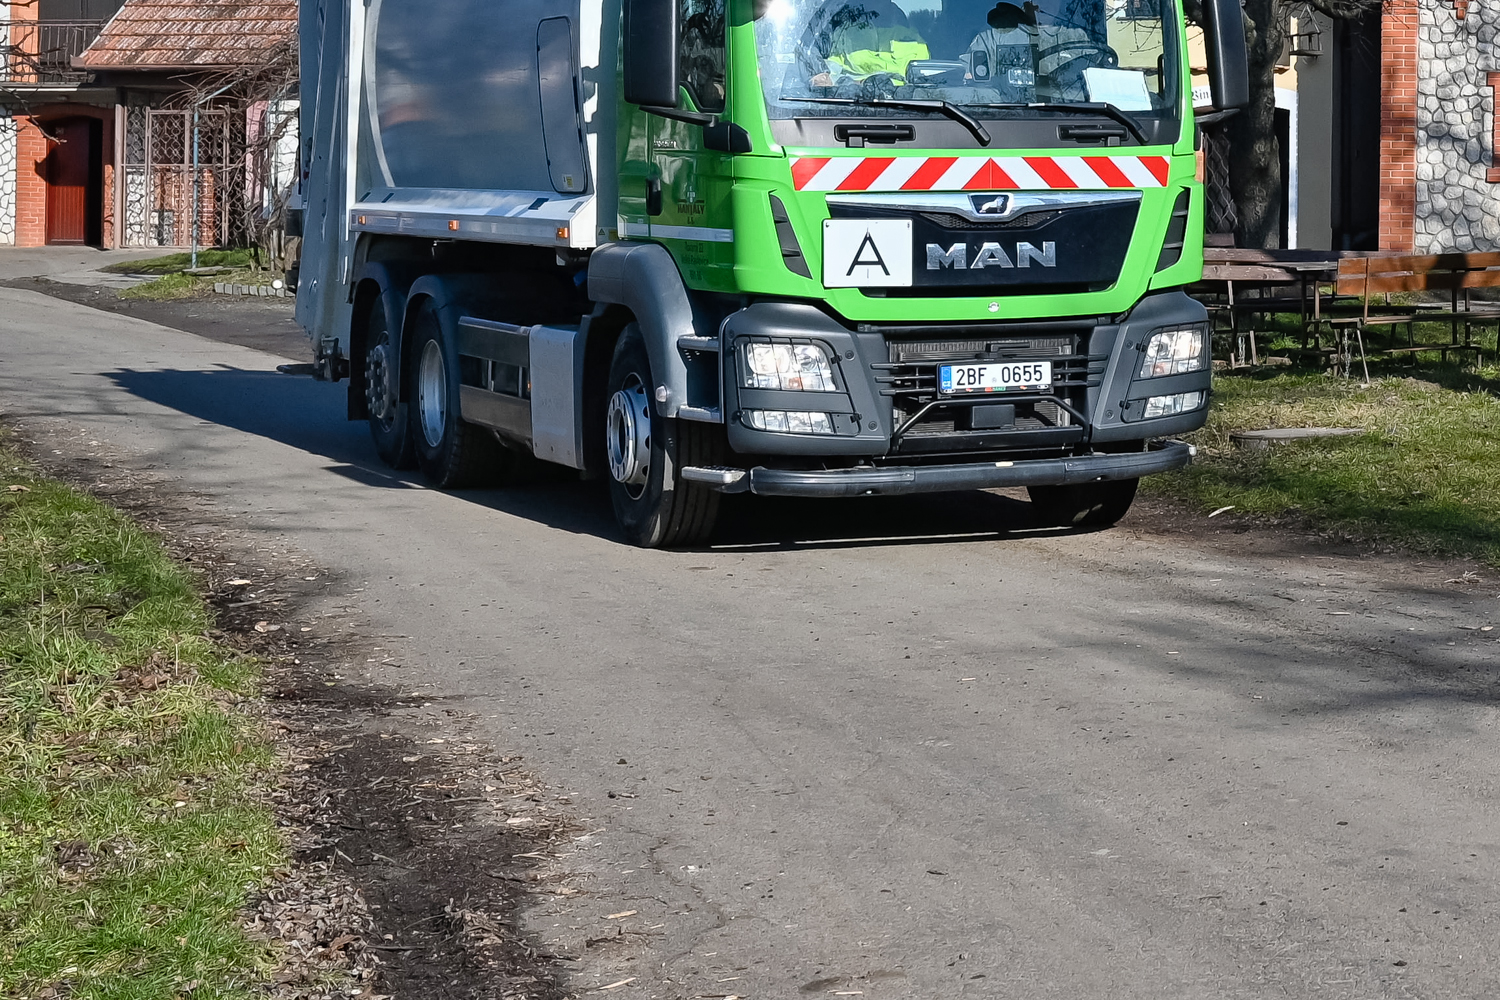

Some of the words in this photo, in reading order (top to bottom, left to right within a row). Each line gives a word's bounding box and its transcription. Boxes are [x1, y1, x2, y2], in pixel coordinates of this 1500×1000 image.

[845, 231, 891, 276] A
[926, 241, 1057, 270] MAN
[956, 367, 987, 386] 2BF
[1001, 364, 1043, 383] 0655
